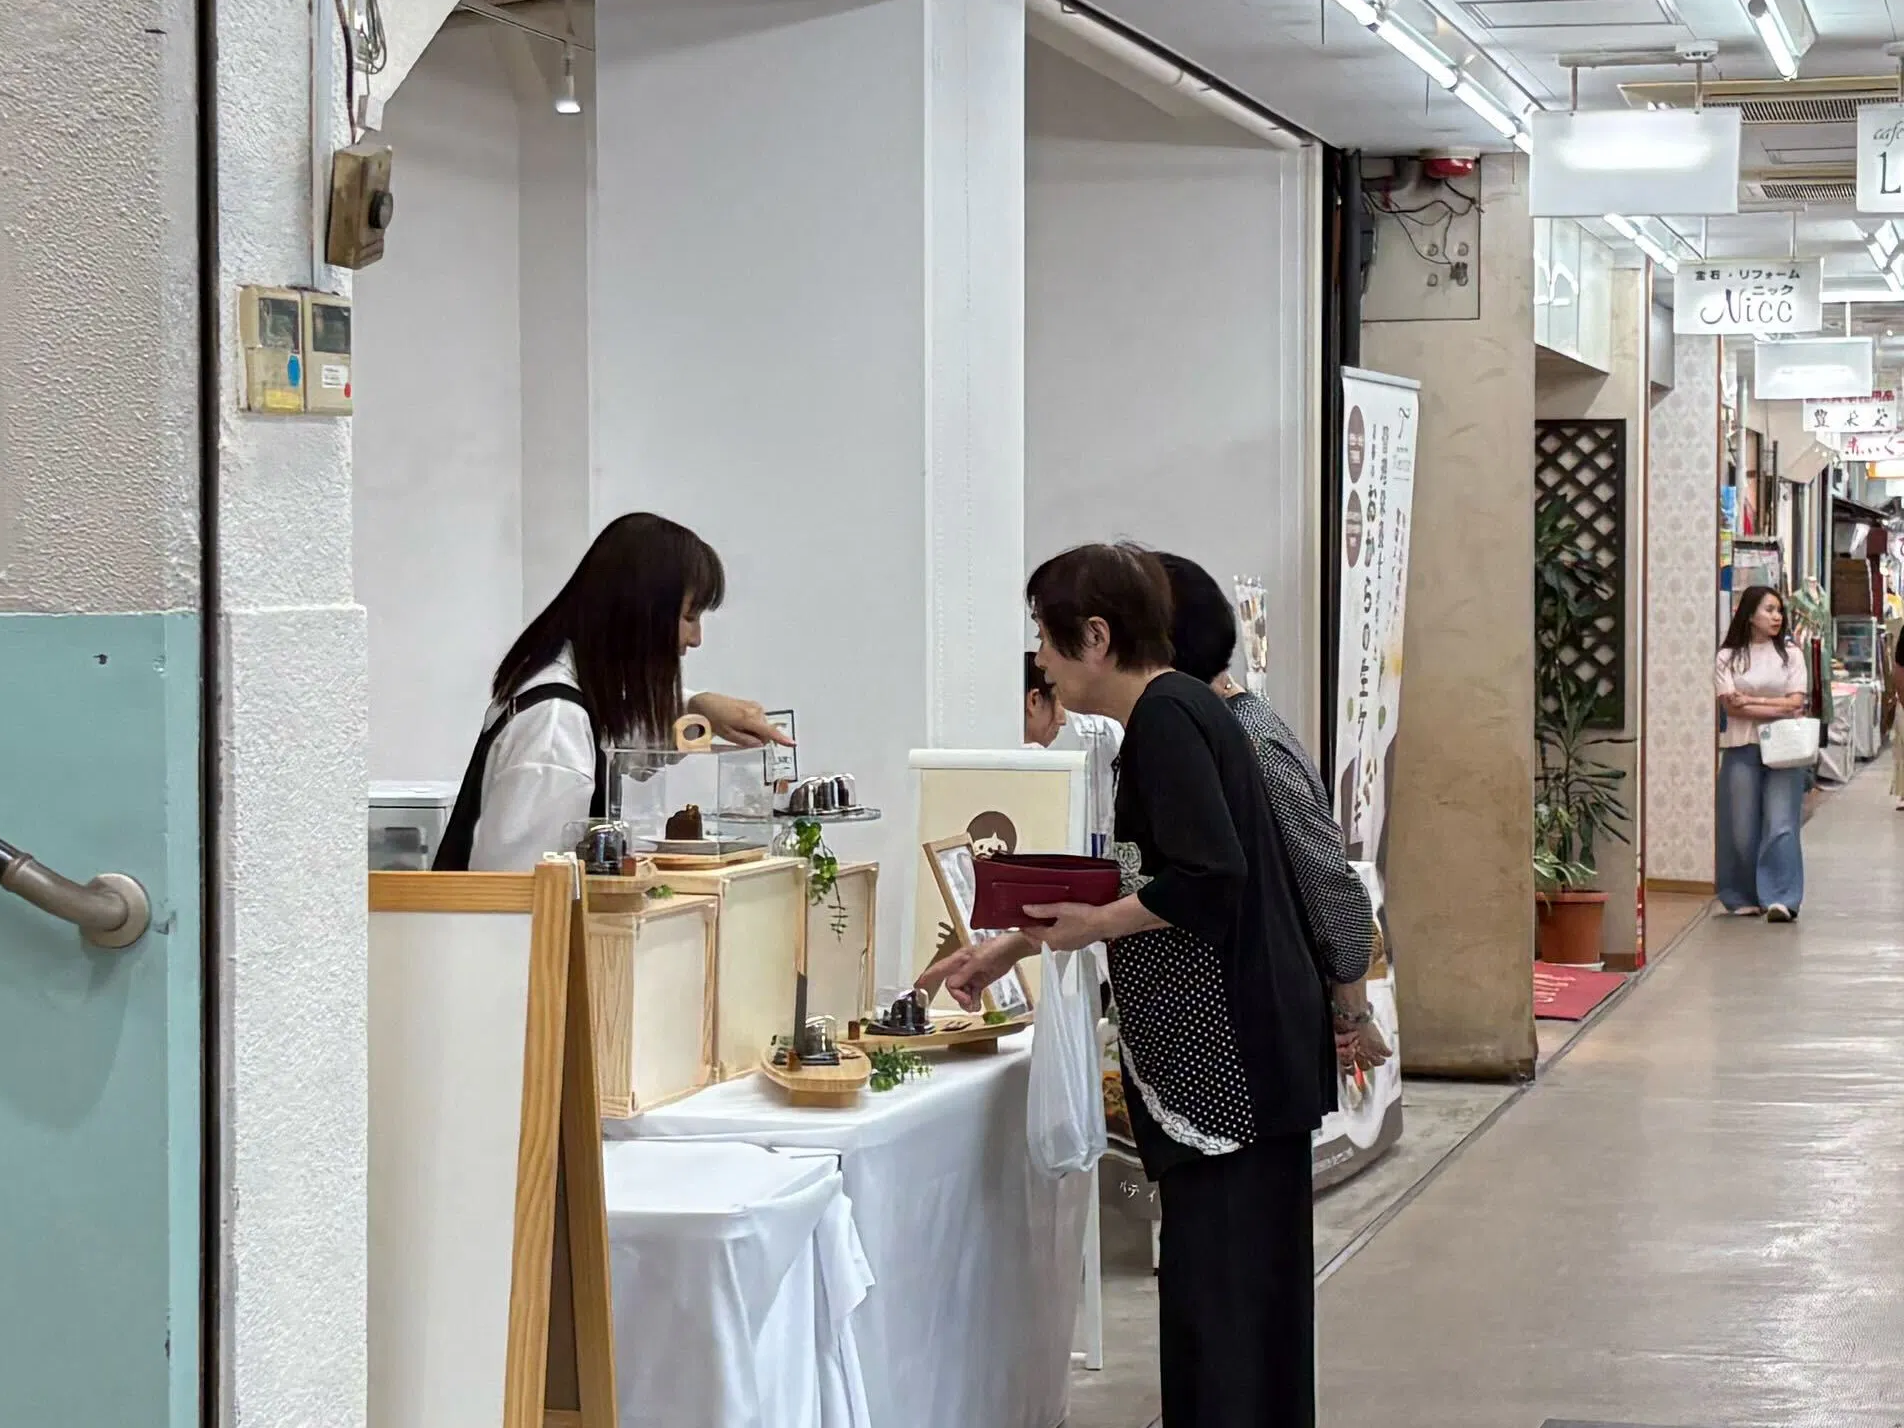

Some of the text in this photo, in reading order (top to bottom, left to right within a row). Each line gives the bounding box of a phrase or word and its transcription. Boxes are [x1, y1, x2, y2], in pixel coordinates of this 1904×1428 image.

[1873, 121, 1904, 147] cafe
[1752, 284, 1794, 296] ニック
